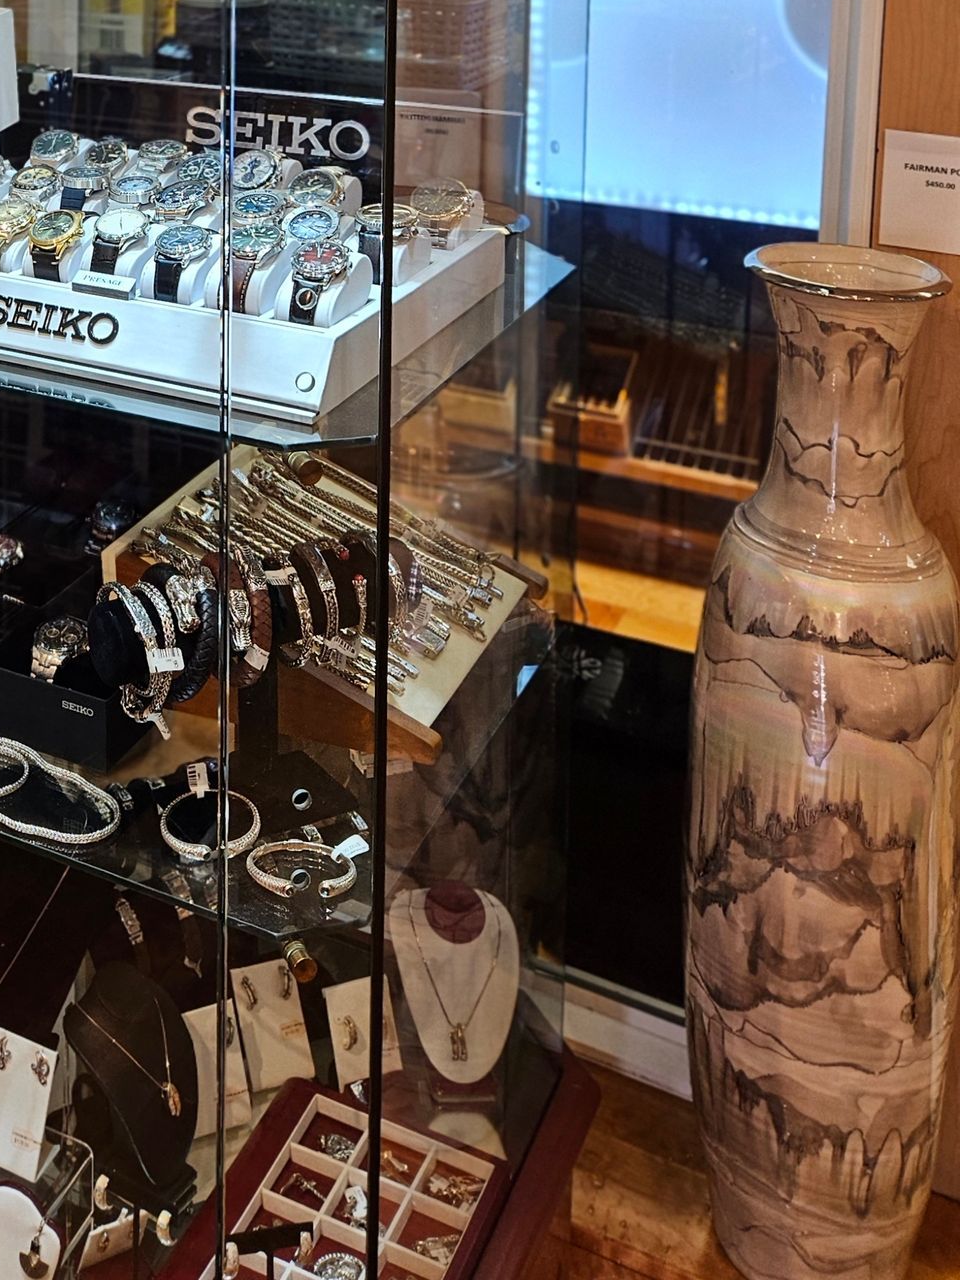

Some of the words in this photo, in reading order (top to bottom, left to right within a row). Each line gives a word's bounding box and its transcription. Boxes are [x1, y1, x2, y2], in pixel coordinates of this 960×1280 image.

[185, 106, 371, 161] SEIKO
[904, 162, 948, 175] FAIRMAN
[925, 179, 956, 190] $450.00
[61, 700, 94, 717] SEIKO
